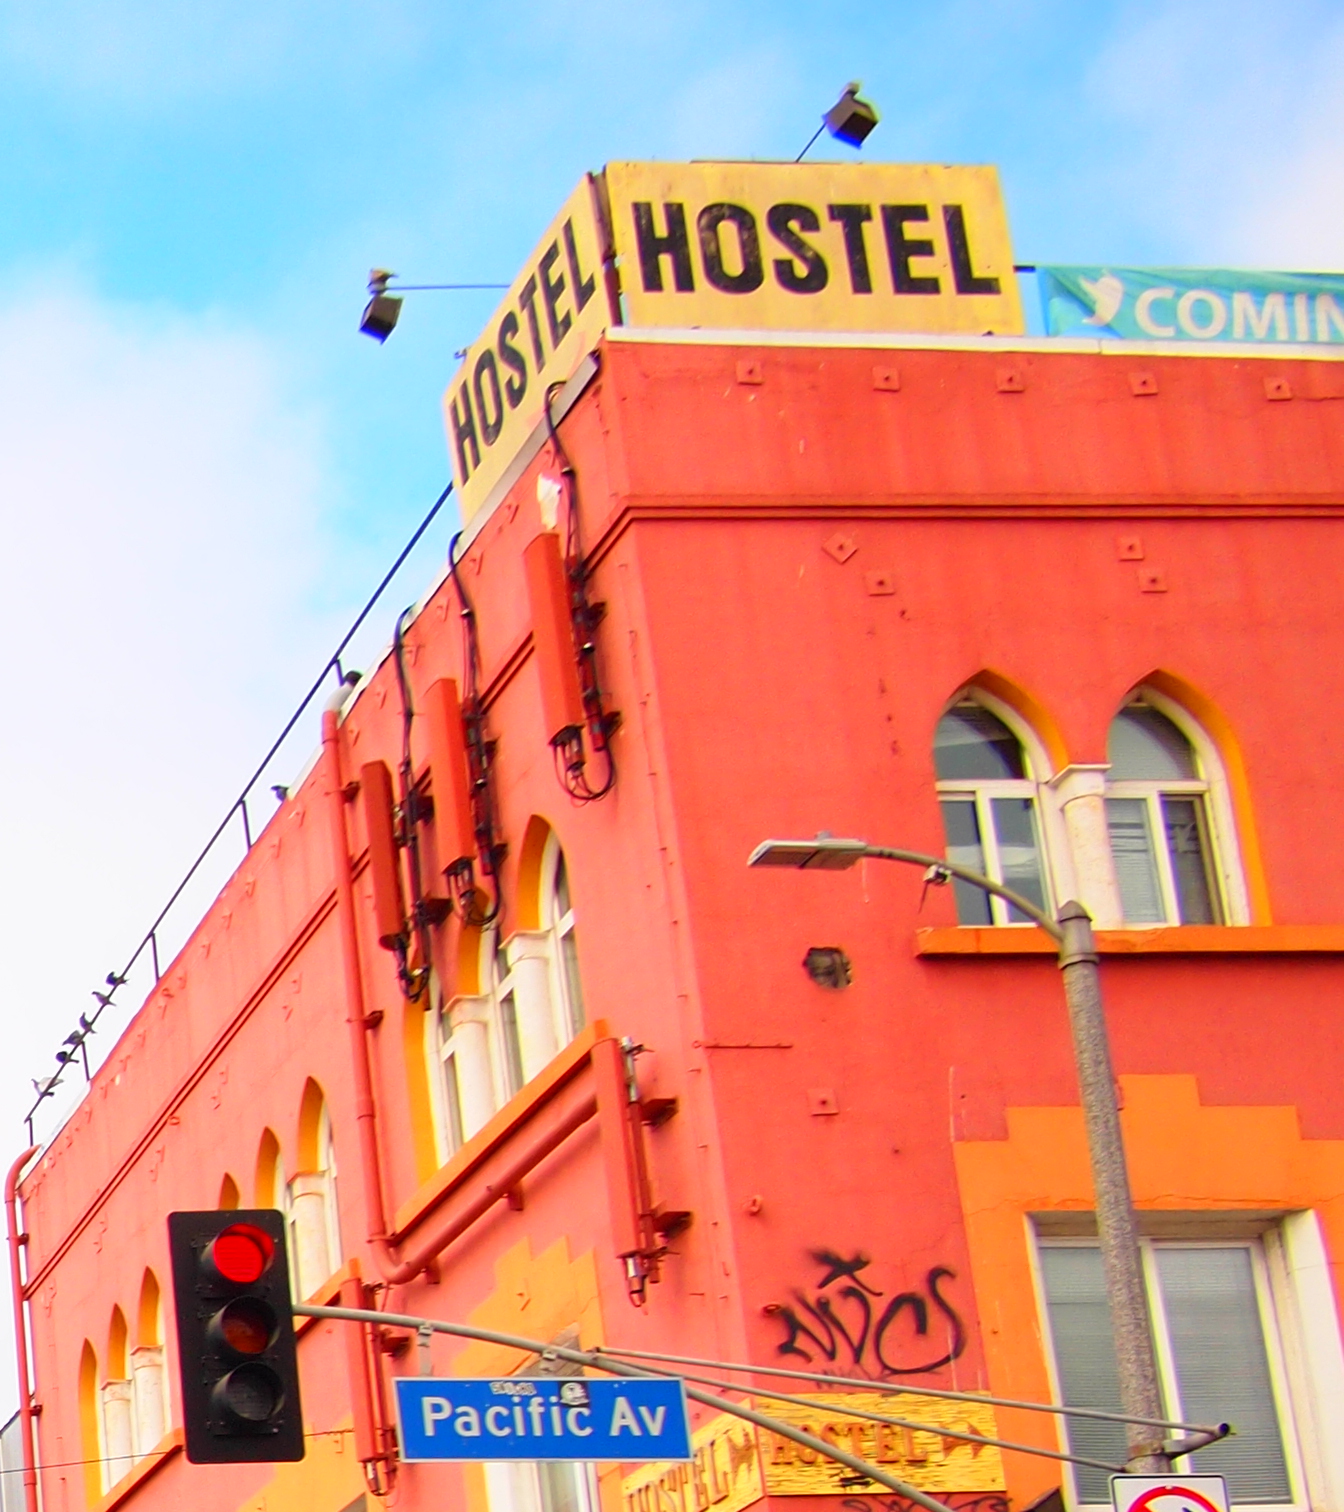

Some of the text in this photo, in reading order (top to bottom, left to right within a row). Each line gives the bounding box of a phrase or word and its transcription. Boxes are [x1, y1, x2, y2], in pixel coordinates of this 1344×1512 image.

[631, 201, 1002, 296] HOSTEL
[450, 215, 596, 488] HOSTEL
[421, 1396, 667, 1437] Pacific Av
